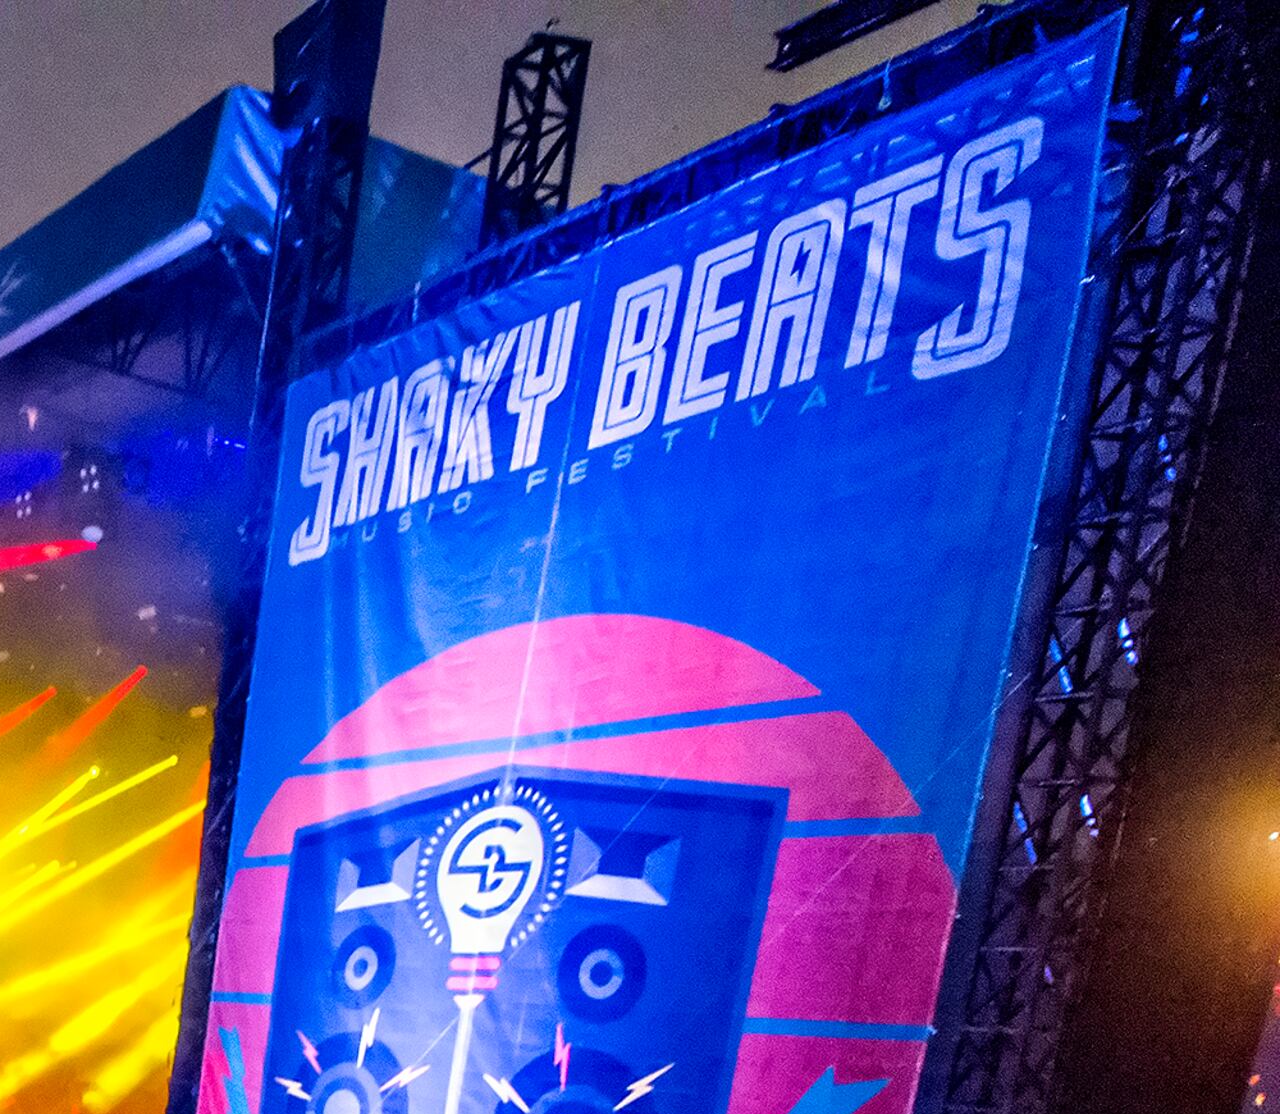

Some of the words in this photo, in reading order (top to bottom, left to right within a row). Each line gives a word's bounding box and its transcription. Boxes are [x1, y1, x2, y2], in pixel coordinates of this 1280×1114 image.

[289, 301, 579, 566] SHAKY
[588, 117, 1043, 451] BEATS
[526, 369, 890, 493] FESTIVAL
